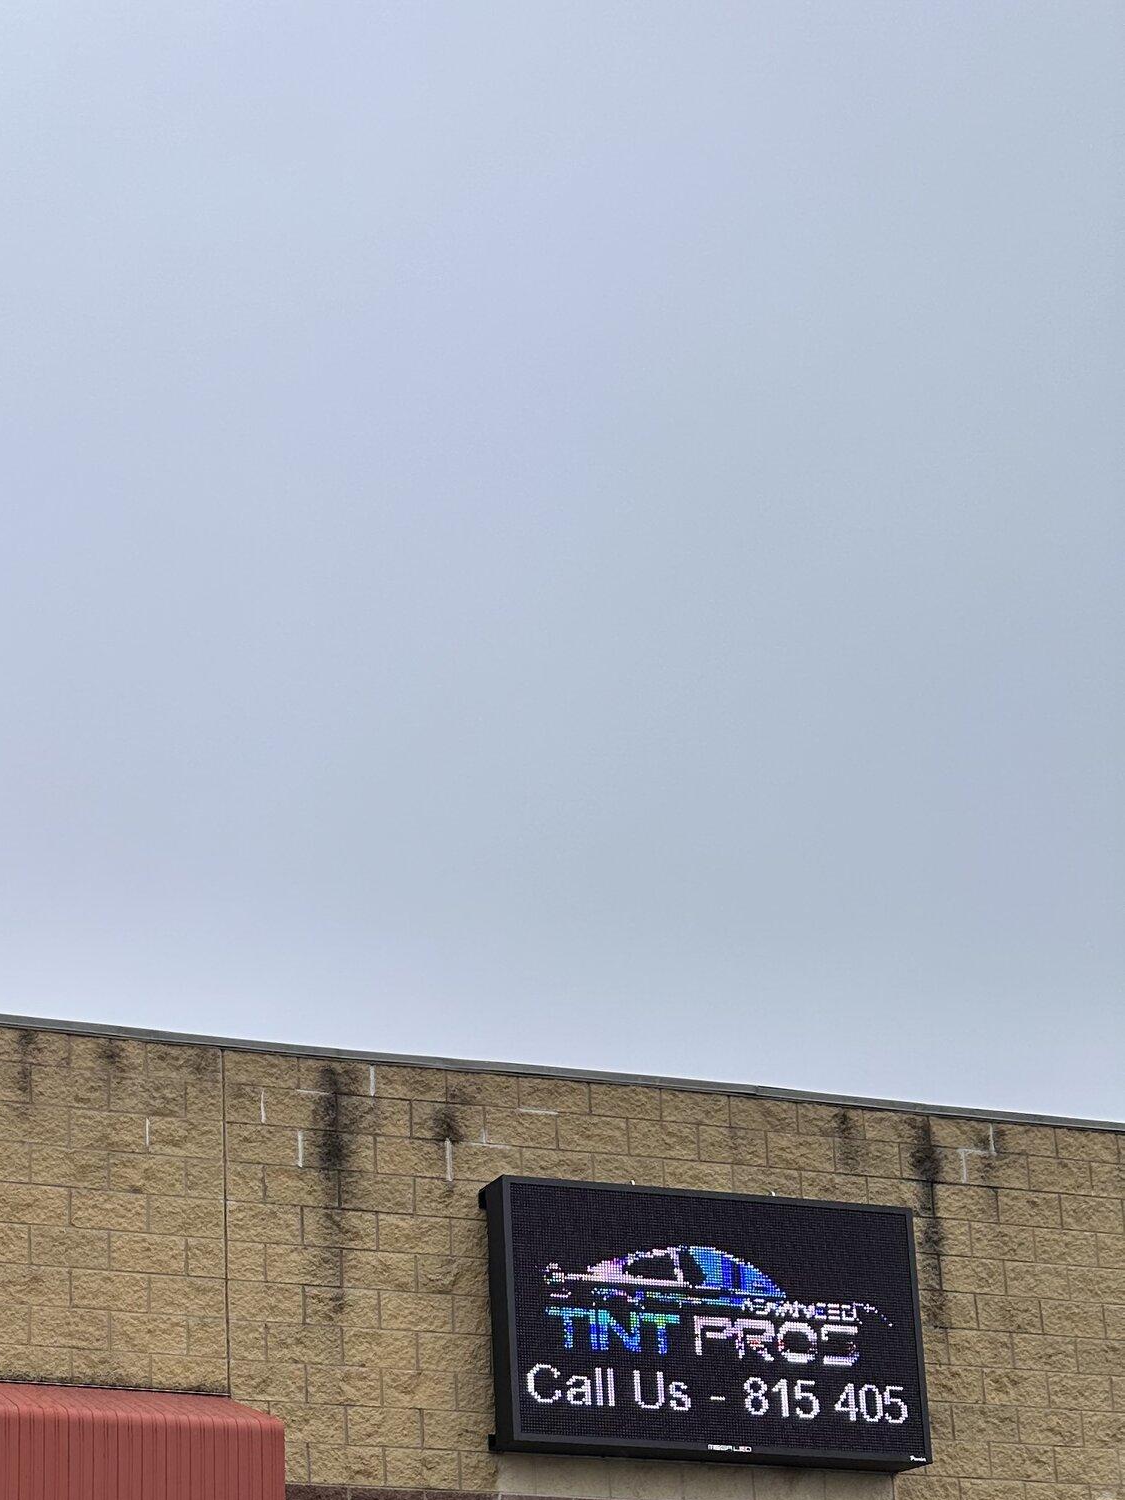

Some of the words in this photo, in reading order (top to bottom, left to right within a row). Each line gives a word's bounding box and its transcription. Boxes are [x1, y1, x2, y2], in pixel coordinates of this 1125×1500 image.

[546, 1307, 680, 1355] TINT
[694, 1315, 860, 1367] PROS
[527, 1363, 615, 1407] Call
[633, 1369, 692, 1411] Us
[744, 1376, 821, 1419] 815
[835, 1382, 909, 1424] 405
